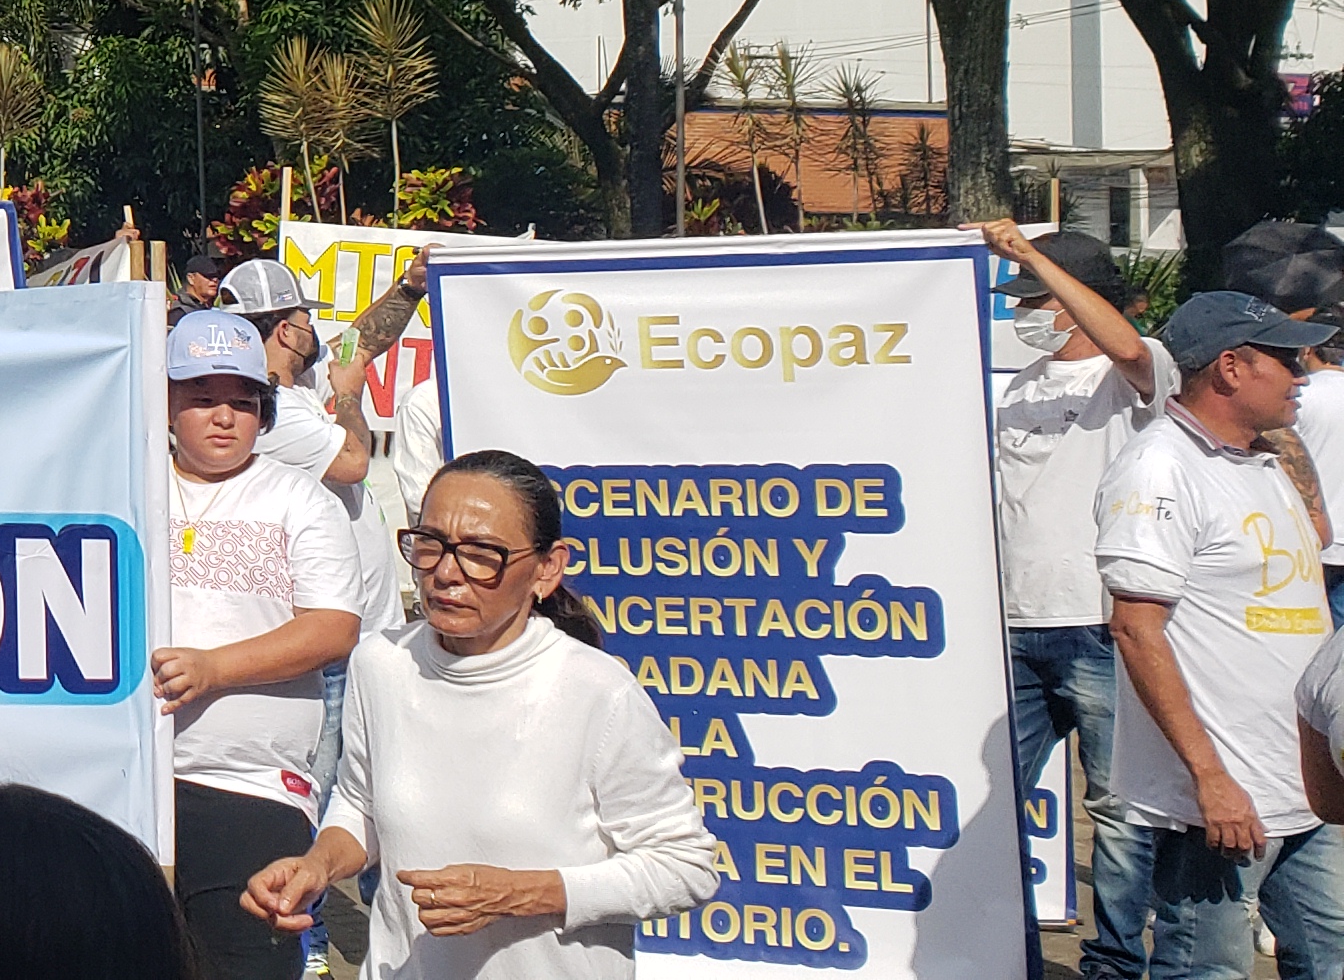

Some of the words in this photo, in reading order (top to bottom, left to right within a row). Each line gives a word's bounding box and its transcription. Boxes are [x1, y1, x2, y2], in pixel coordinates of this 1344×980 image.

[207, 324, 233, 356] LA
[638, 314, 913, 383] Ecopaz
[557, 477, 800, 518] CENARIO
[816, 478, 889, 518] DE
[562, 528, 779, 577] CLUSIÓN
[792, 538, 828, 578] Y
[582, 589, 929, 641] NCERTACIÓN
[625, 655, 820, 700] ADANA
[670, 716, 739, 758] LA
[687, 775, 941, 831] RUCCIÓN
[755, 842, 827, 887] EN
[843, 848, 914, 894] EL
